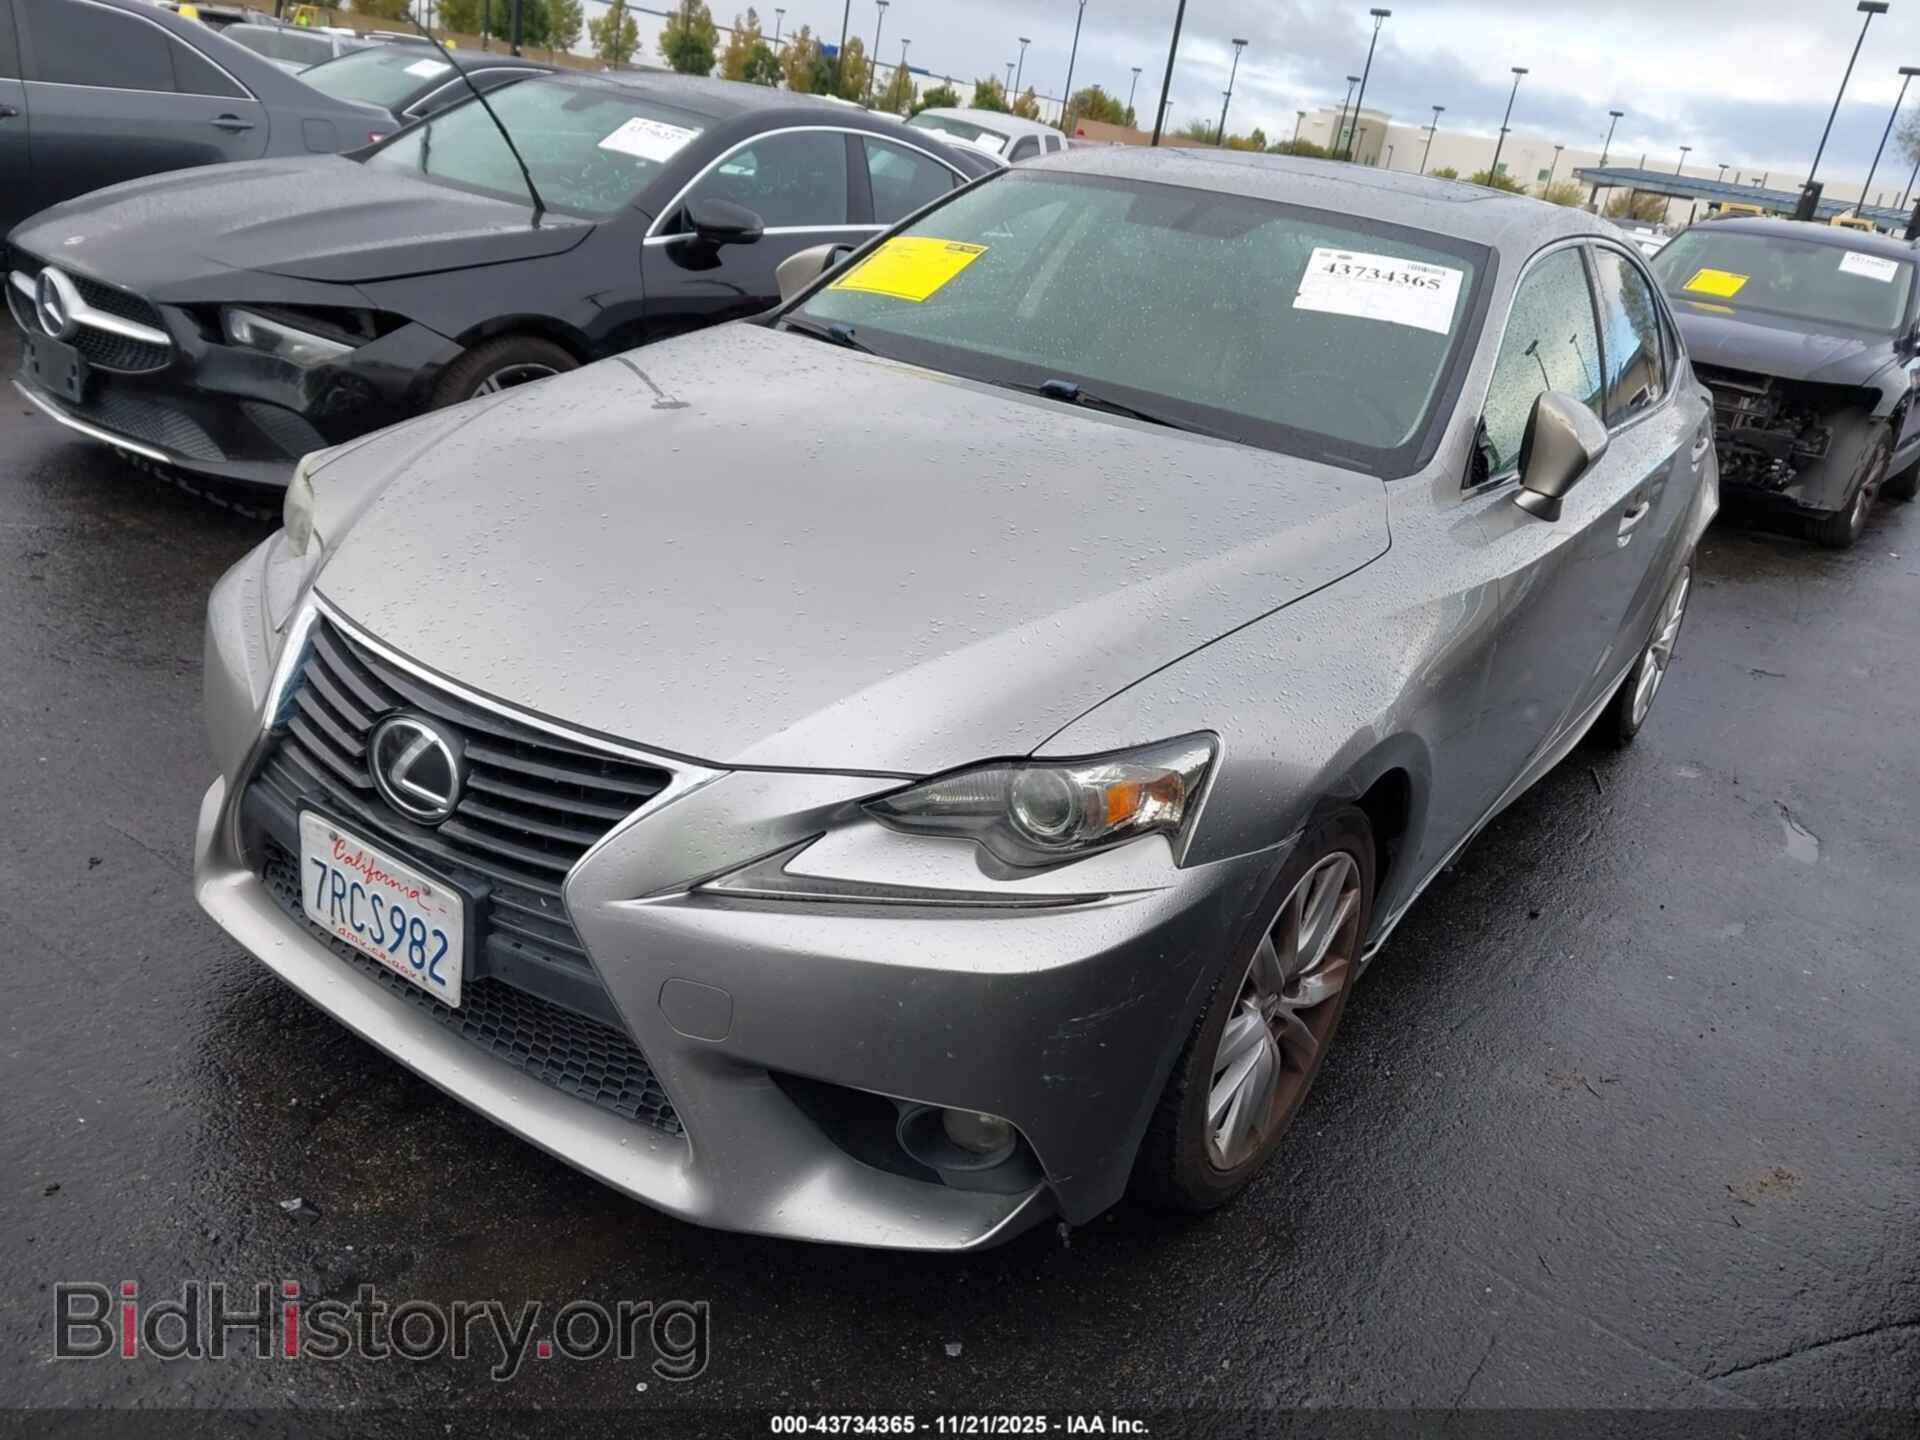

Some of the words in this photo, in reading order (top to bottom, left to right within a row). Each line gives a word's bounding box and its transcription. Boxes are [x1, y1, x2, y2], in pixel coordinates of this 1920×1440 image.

[1322, 263, 1441, 290] 43734365
[333, 838, 430, 911] California
[310, 857, 448, 986] 7RCS982
